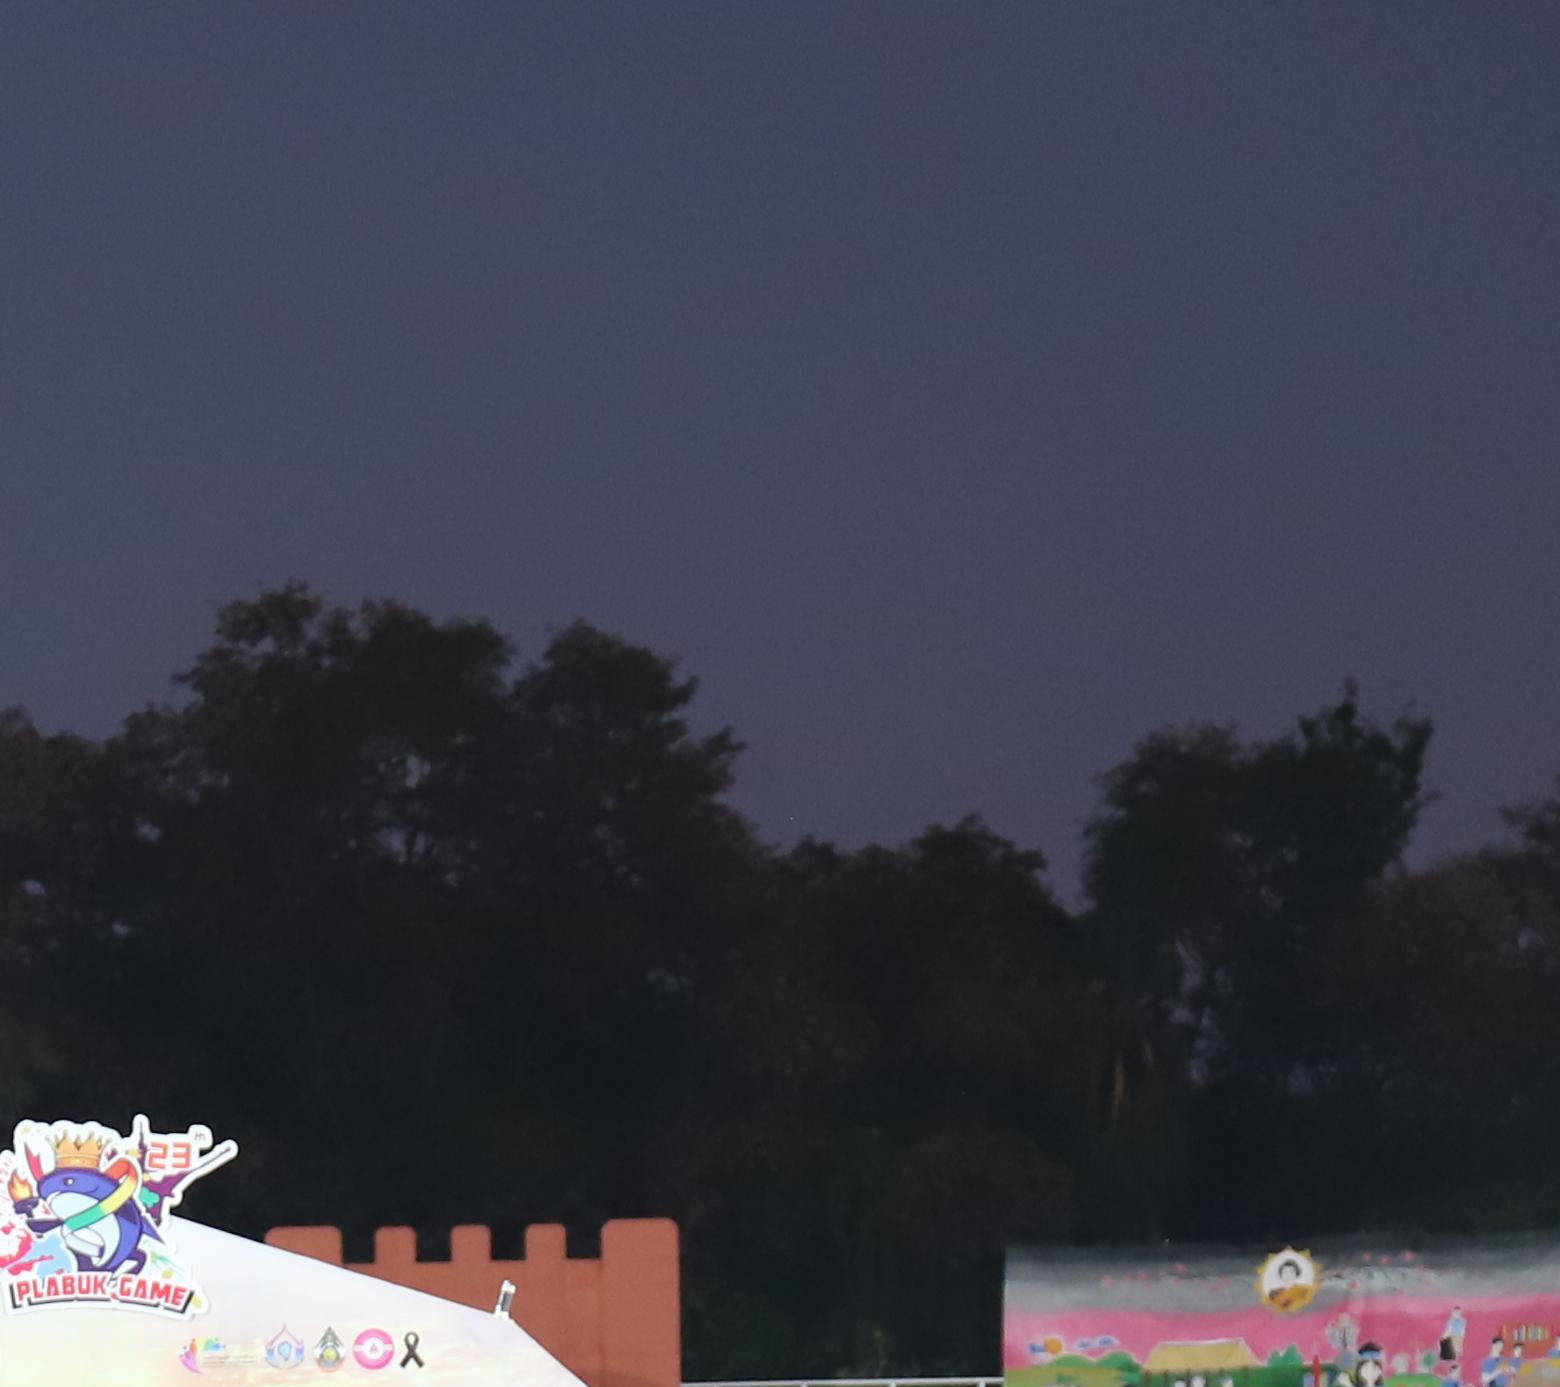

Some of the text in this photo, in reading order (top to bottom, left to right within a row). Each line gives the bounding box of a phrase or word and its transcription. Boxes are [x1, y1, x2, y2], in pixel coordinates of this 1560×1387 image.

[147, 1141, 192, 1170] 23
[15, 1274, 189, 1306] PLABUK GAME
